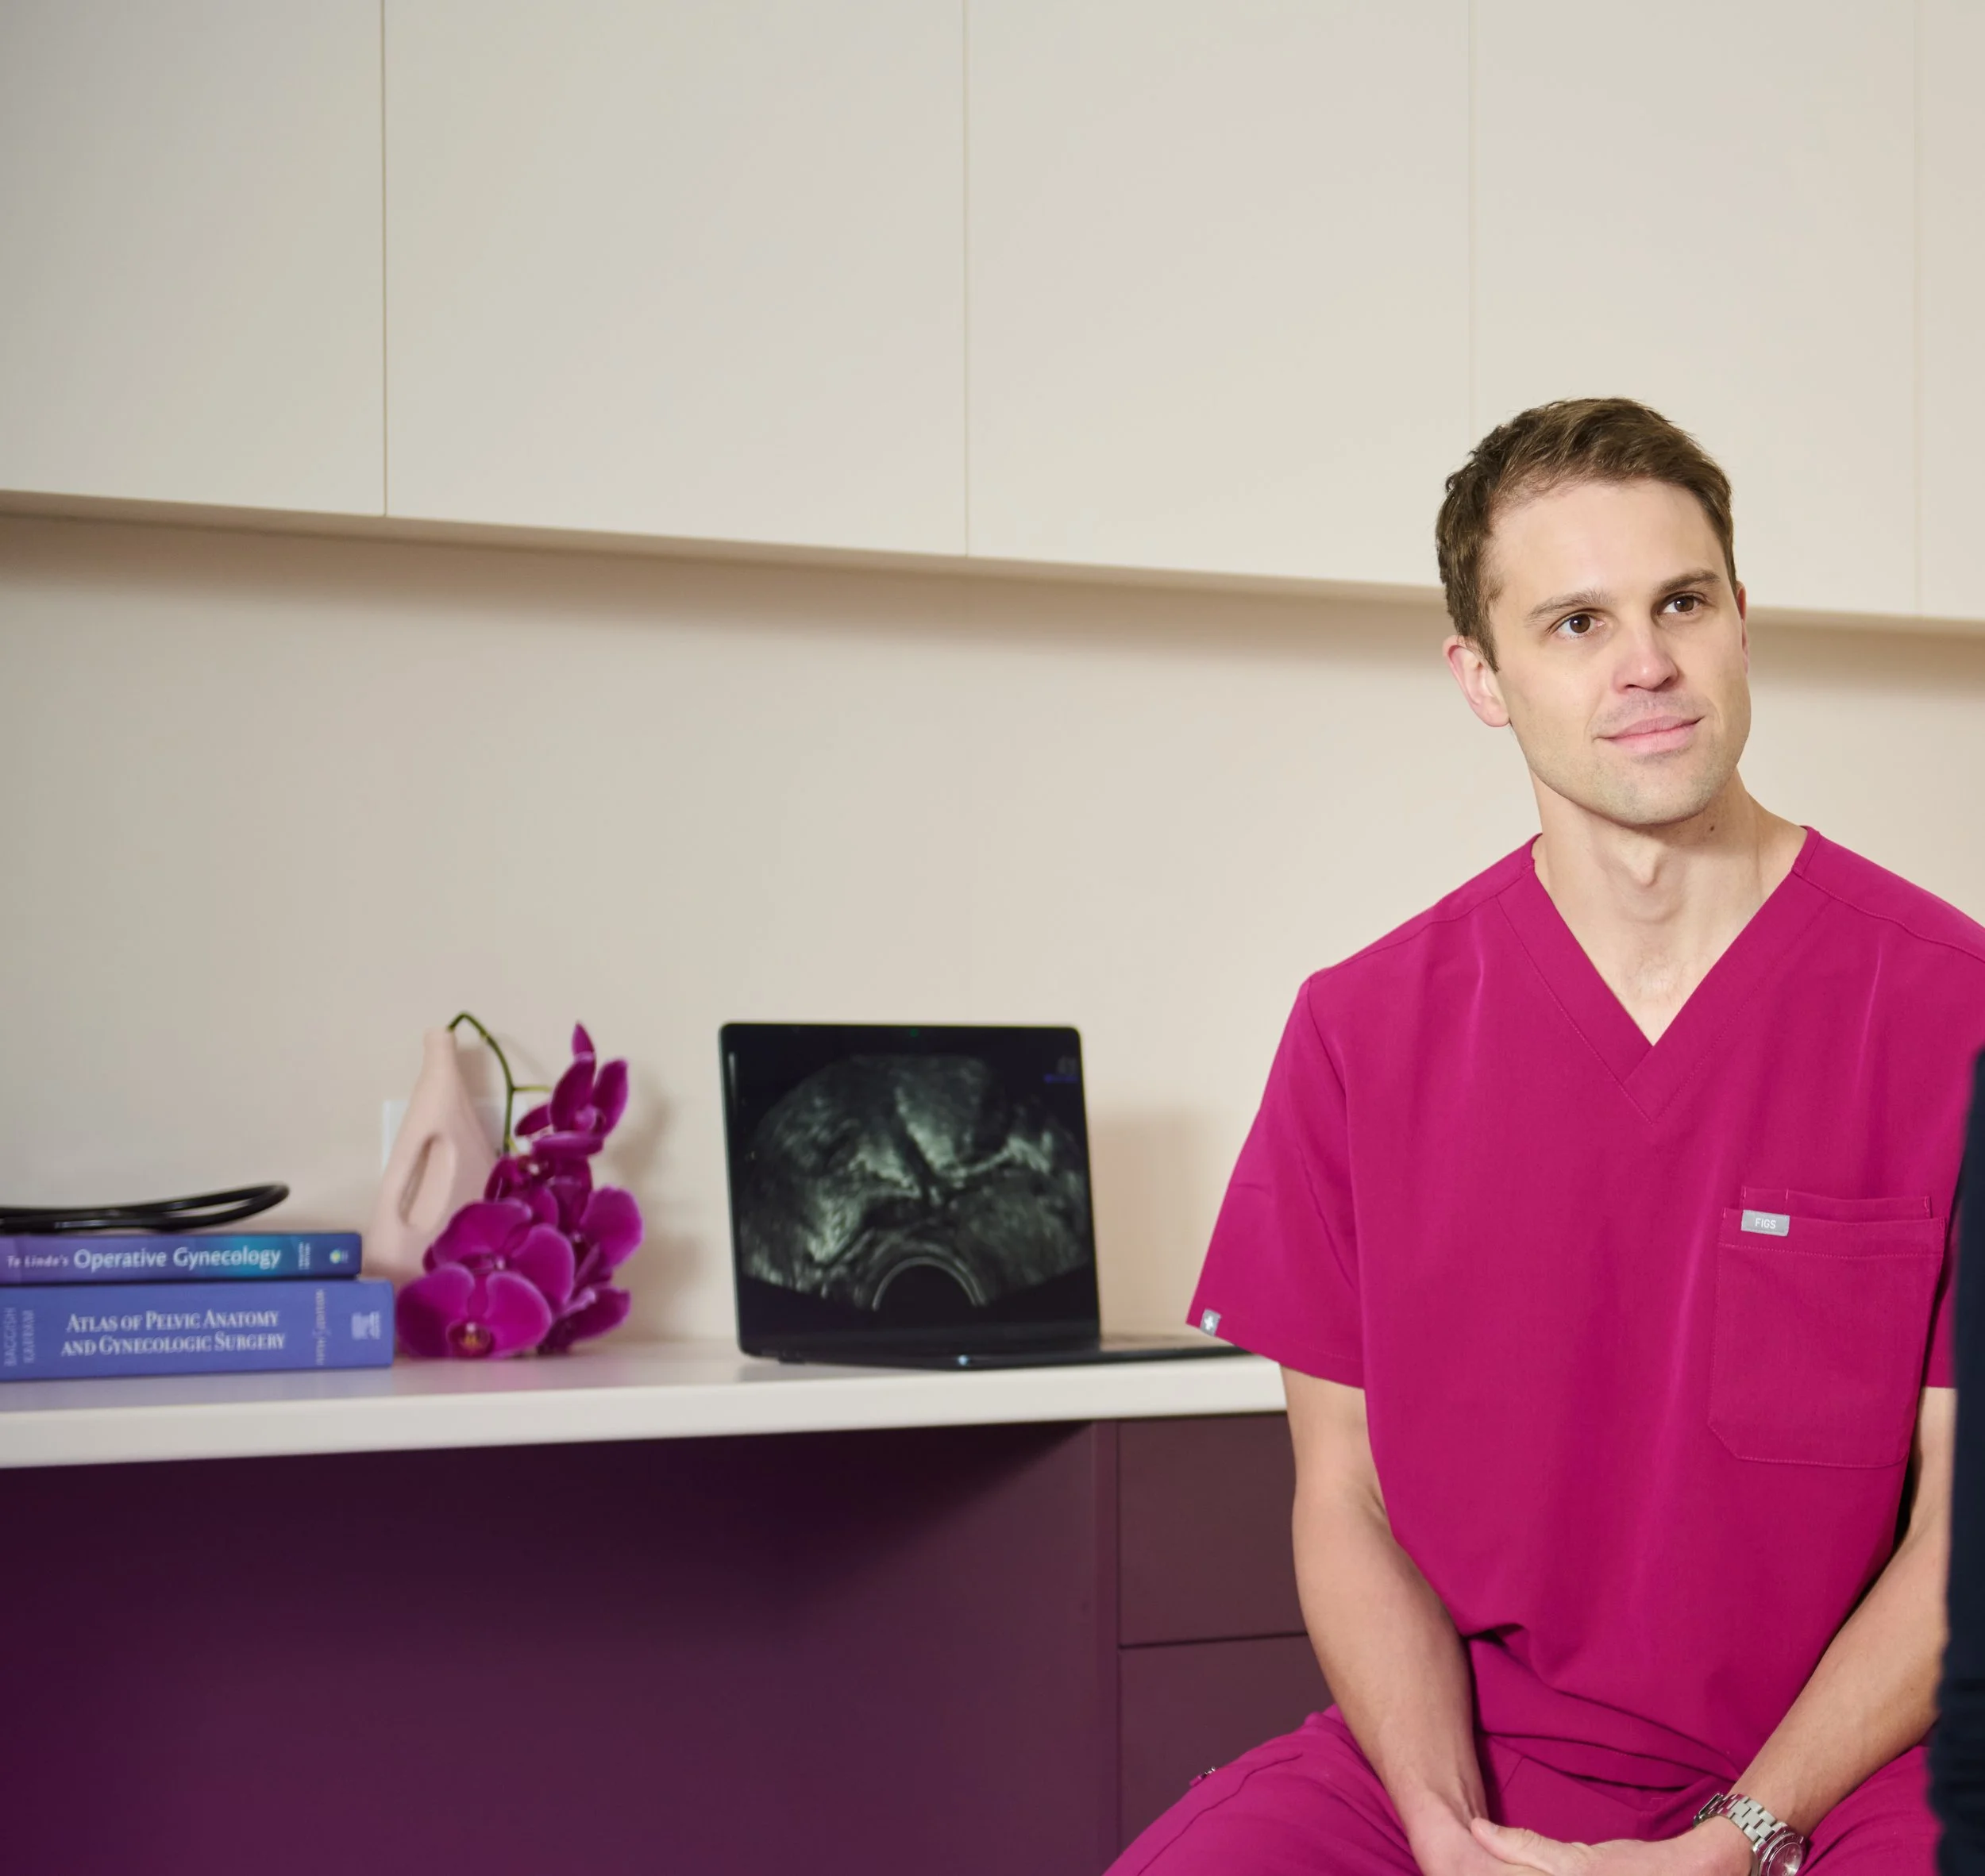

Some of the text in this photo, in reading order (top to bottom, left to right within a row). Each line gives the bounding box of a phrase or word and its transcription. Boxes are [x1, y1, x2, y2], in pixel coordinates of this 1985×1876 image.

[1755, 1217, 1777, 1230] FIGS
[74, 1247, 167, 1273] Operative
[173, 1245, 281, 1270] Gynecology
[66, 1308, 279, 1333] ATLAS OF PELVIC ANATOMY
[61, 1330, 285, 1357] AND GYNECOLOGIC SURGERY
